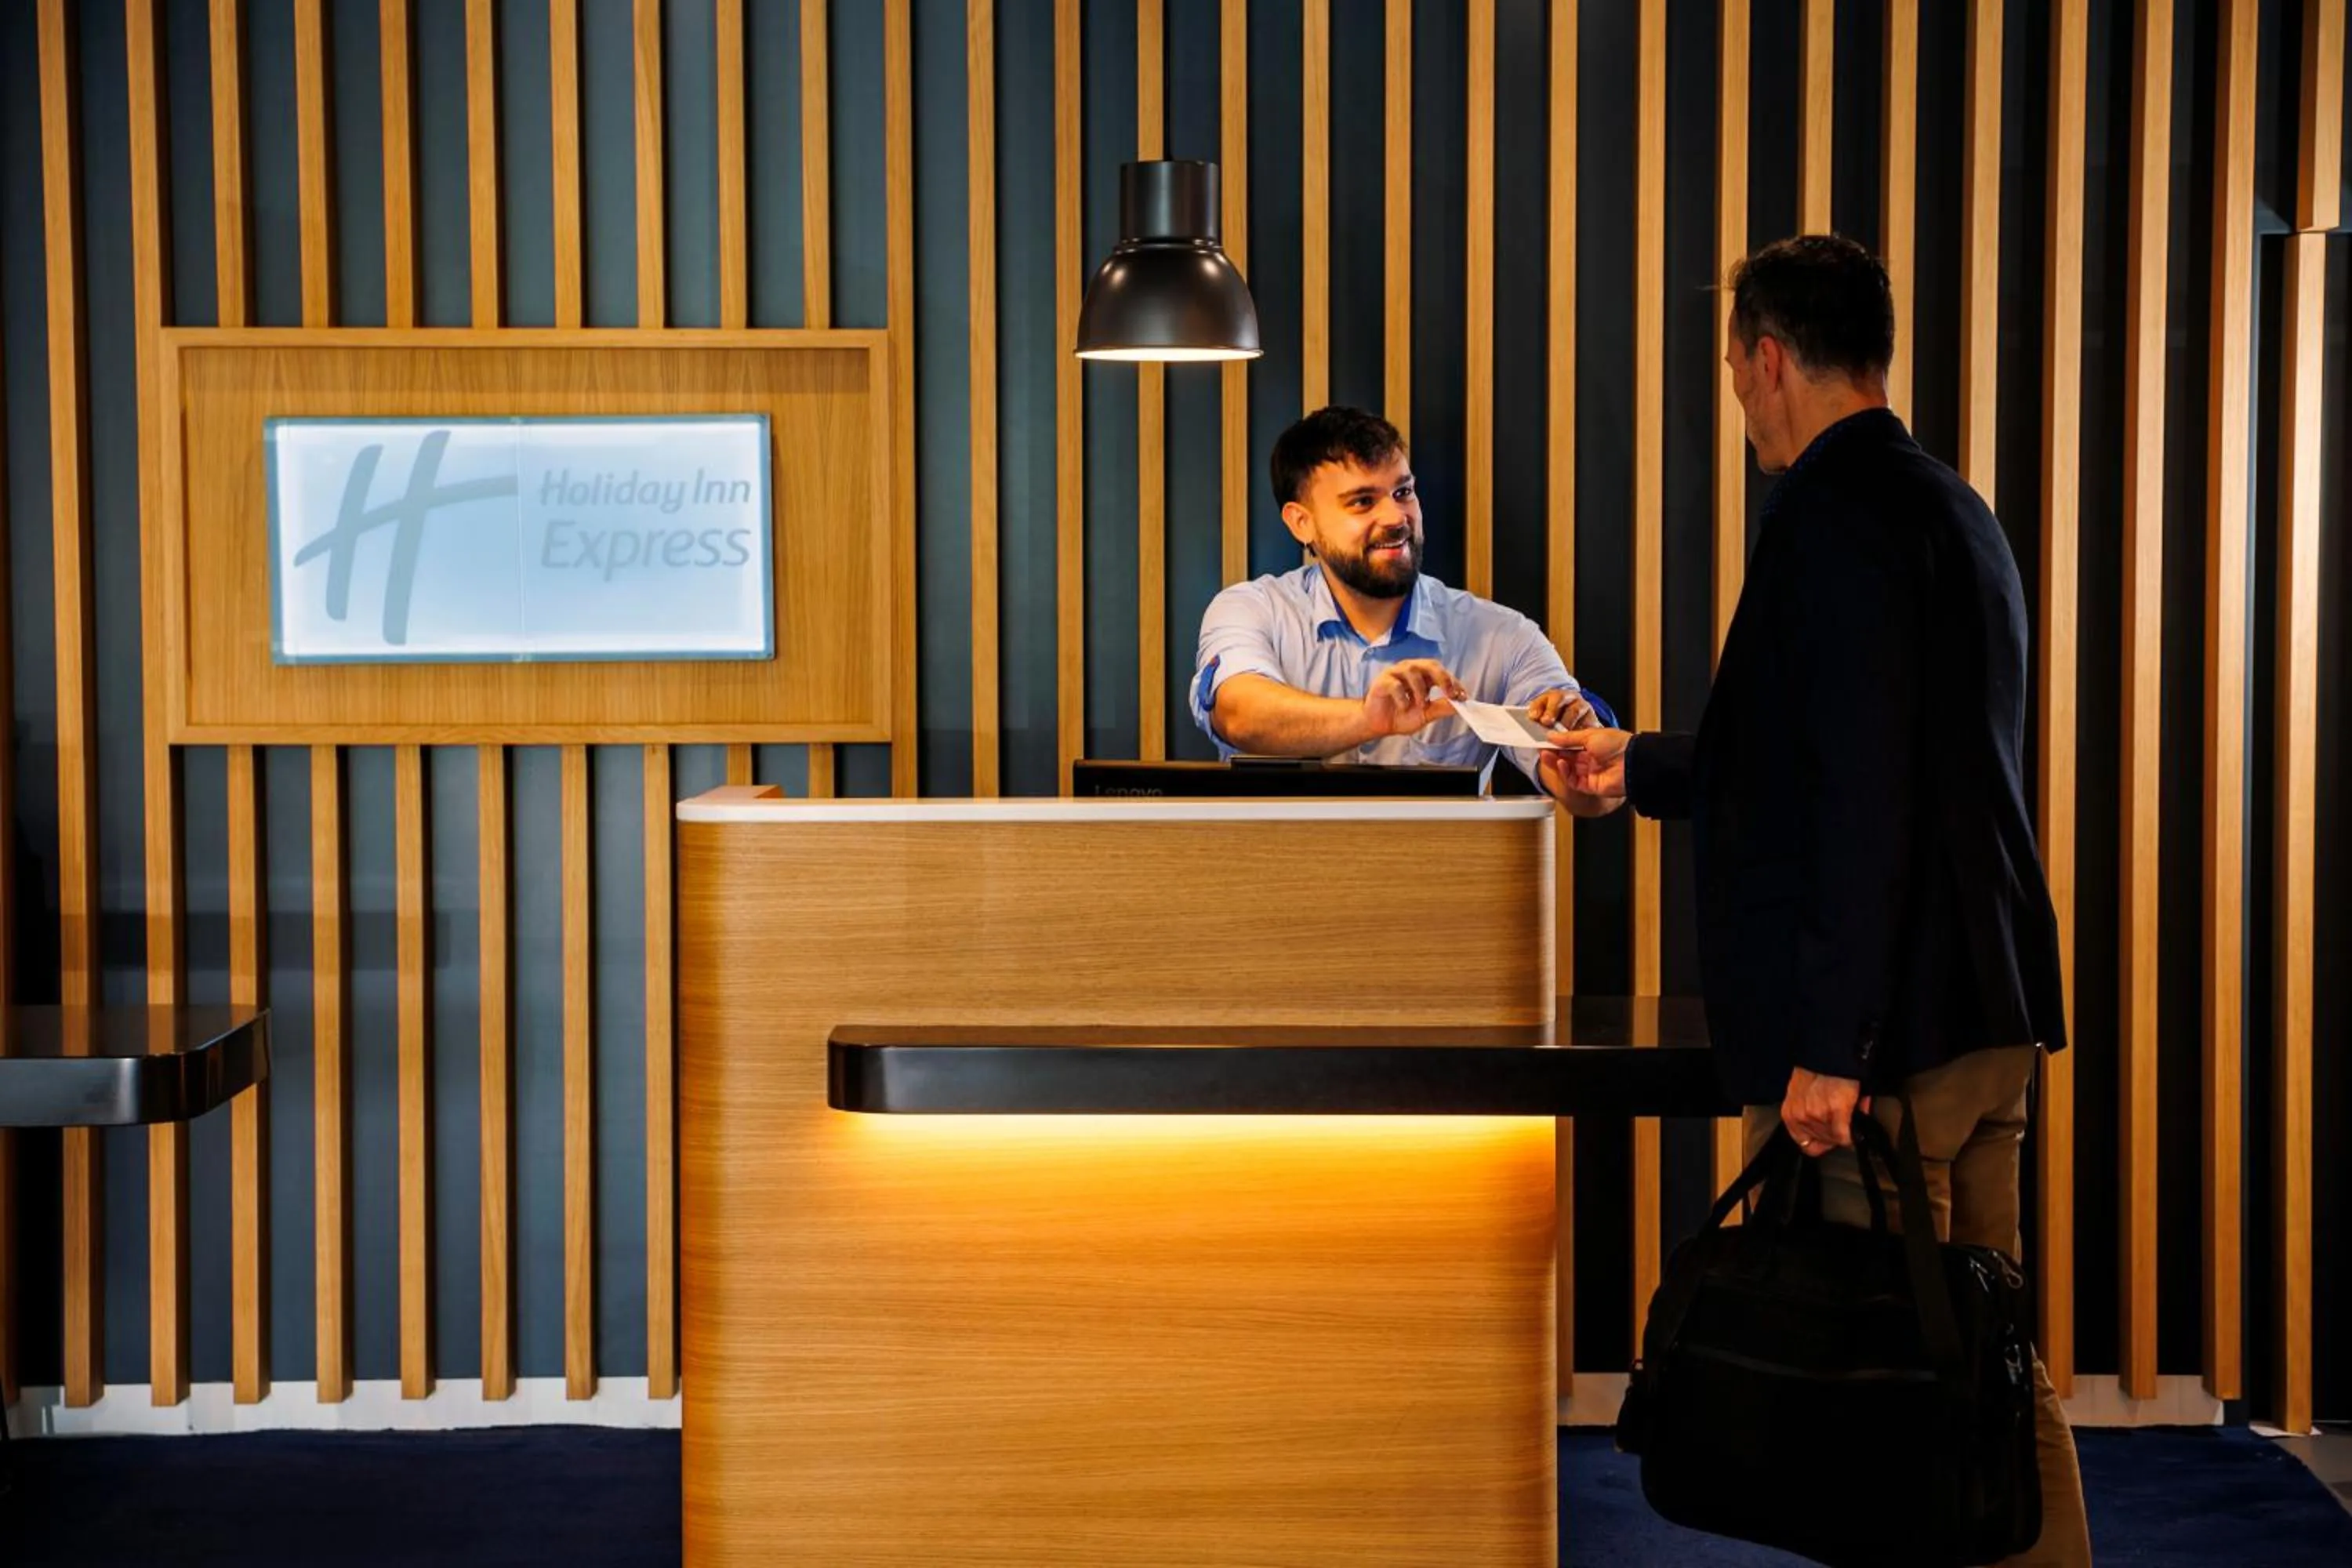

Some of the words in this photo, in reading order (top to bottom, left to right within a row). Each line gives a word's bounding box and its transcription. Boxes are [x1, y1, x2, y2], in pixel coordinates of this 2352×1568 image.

[538, 467, 685, 514] Holiday
[693, 467, 751, 504] Inn
[540, 519, 752, 582] Express
